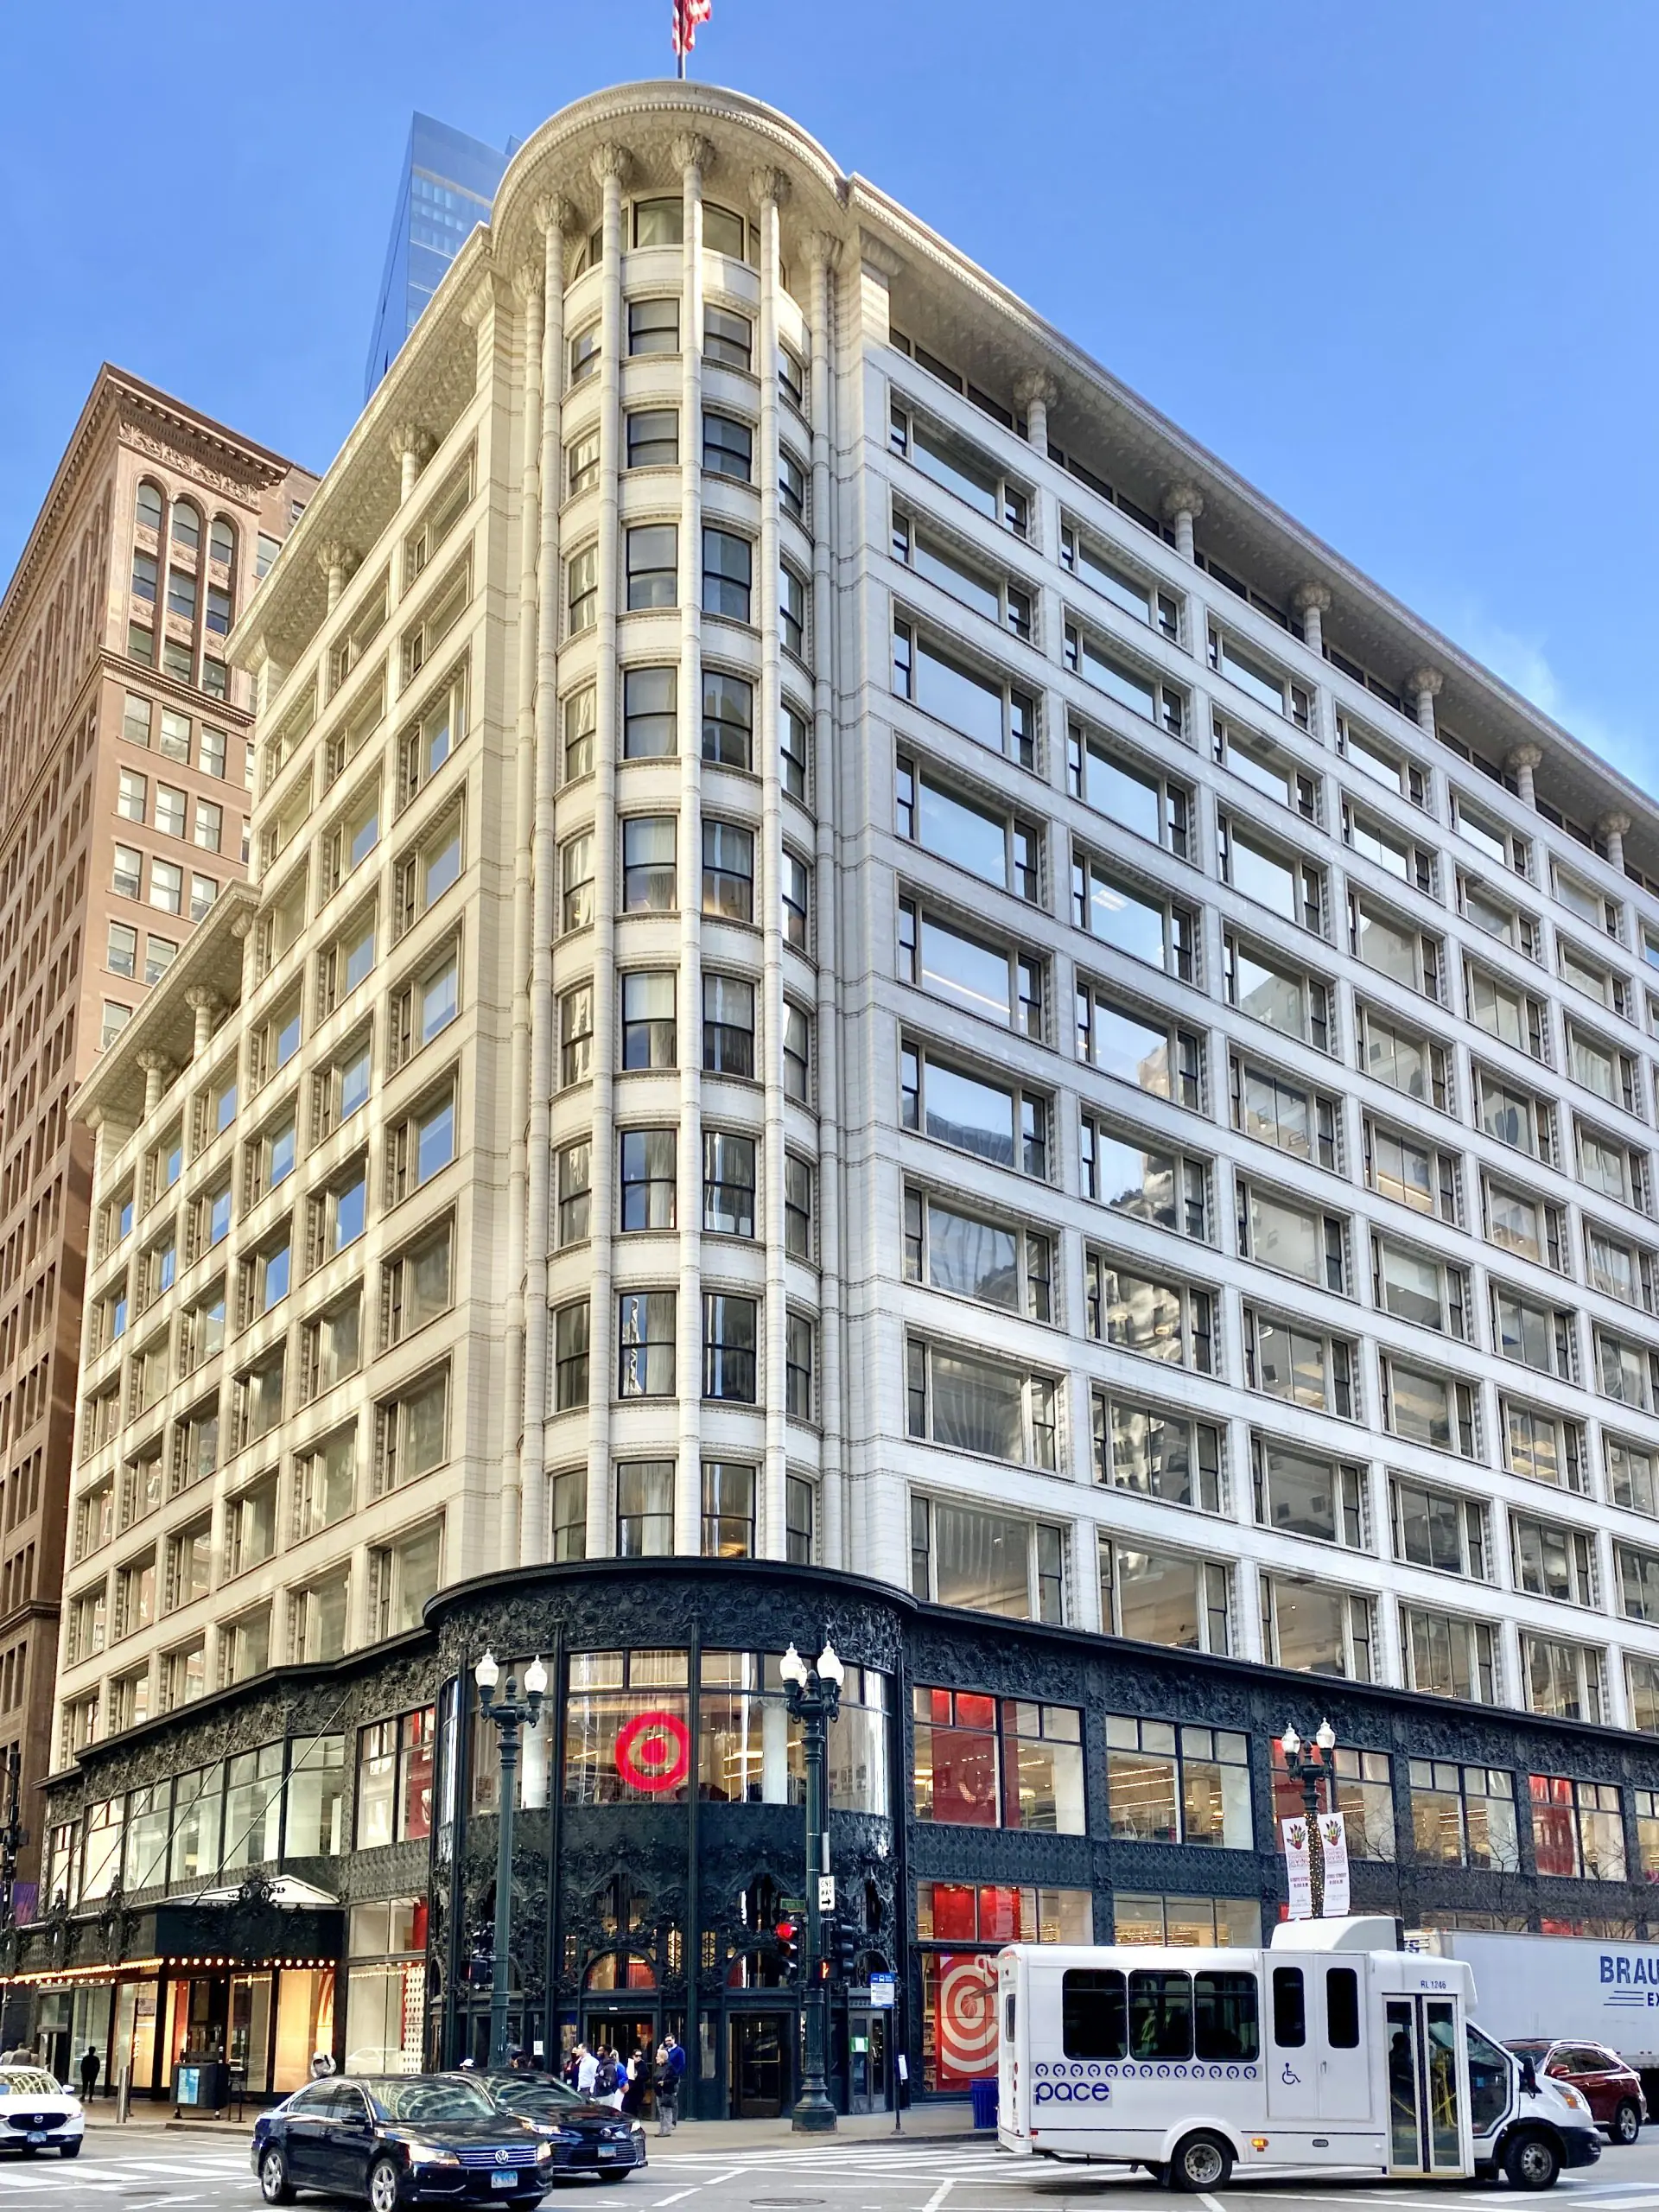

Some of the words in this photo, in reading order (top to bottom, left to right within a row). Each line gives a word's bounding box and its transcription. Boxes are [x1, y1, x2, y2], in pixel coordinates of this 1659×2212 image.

[820, 1879, 832, 1888] ONE
[1600, 1955, 1659, 1985] BRAU
[1421, 1980, 1430, 1989] RL
[1035, 2082, 1110, 2106] pace
